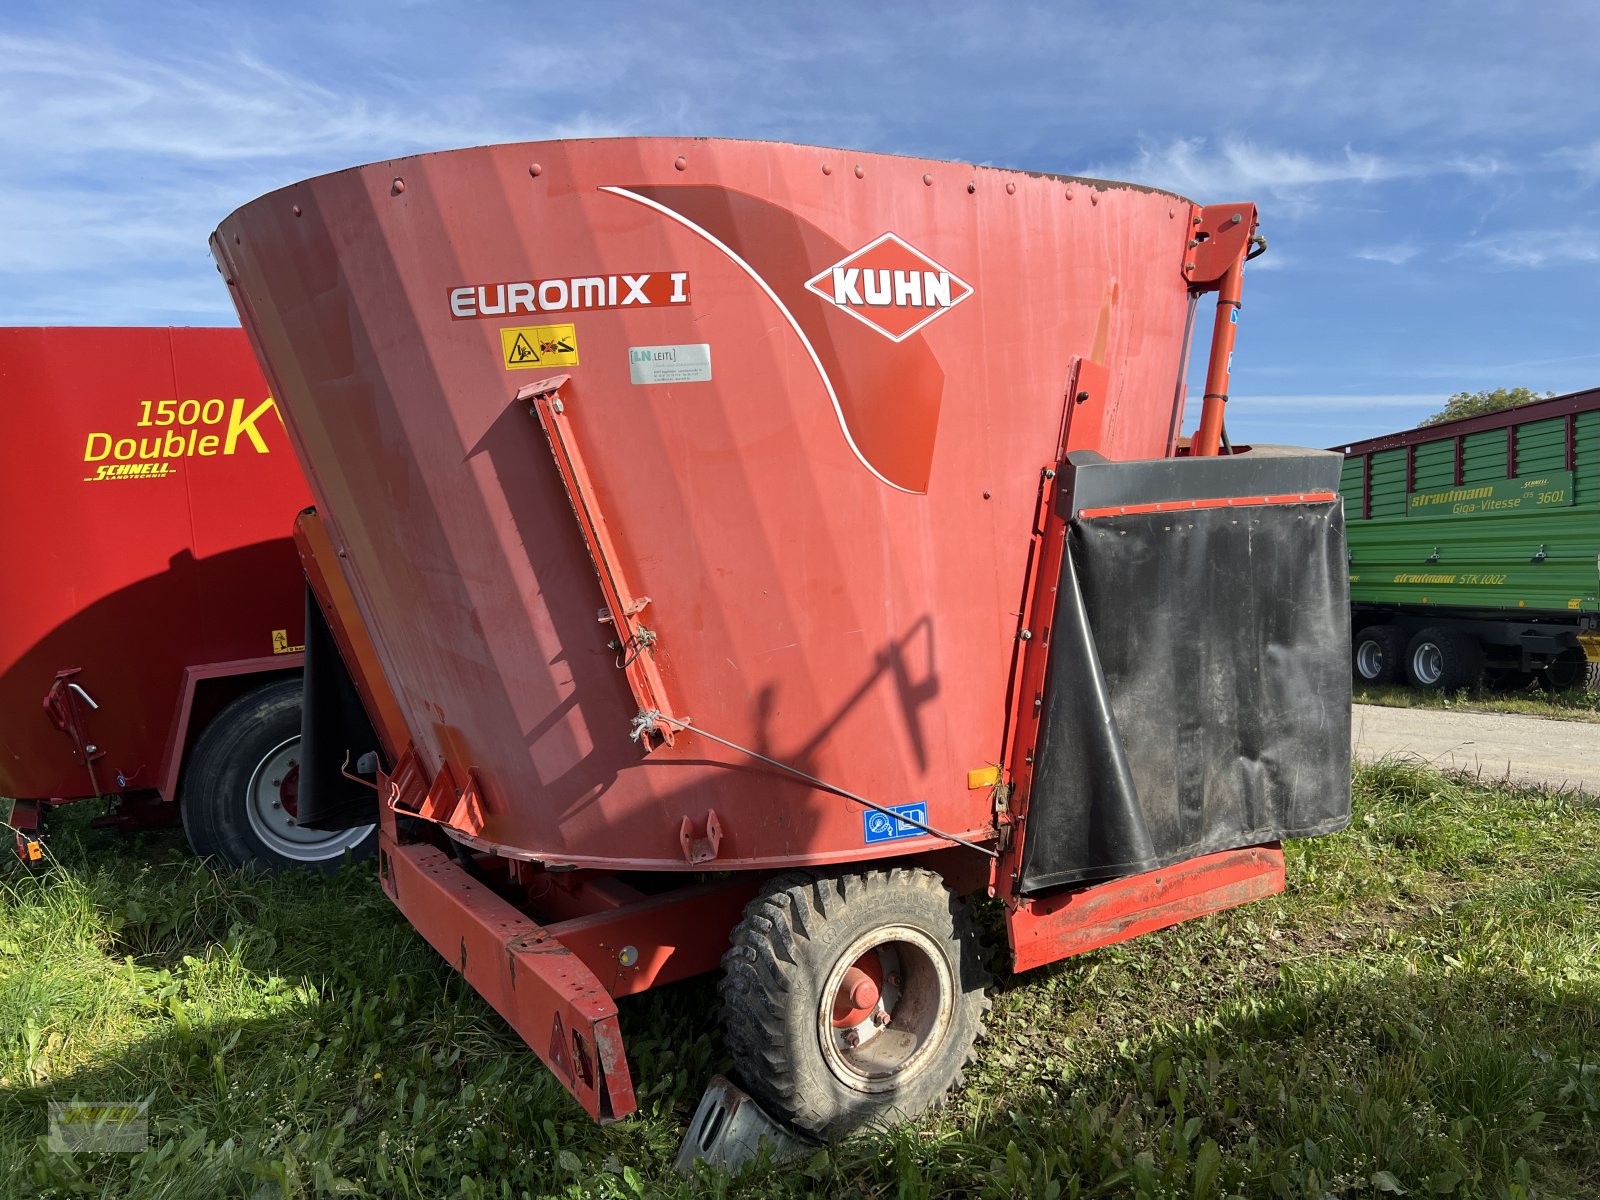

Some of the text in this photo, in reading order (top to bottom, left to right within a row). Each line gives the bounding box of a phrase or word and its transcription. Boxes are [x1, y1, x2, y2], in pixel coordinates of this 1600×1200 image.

[450, 272, 687, 317] EUROMIX I
[832, 267, 951, 307] KUHN
[136, 399, 225, 427] 1500
[92, 463, 171, 481] SCHNELL
[1411, 486, 1494, 507] strautmann
[1452, 497, 1521, 515] Giga-Vitesse
[1536, 490, 1565, 505] 3601
[1393, 573, 1508, 585] strautmann STK 1002
